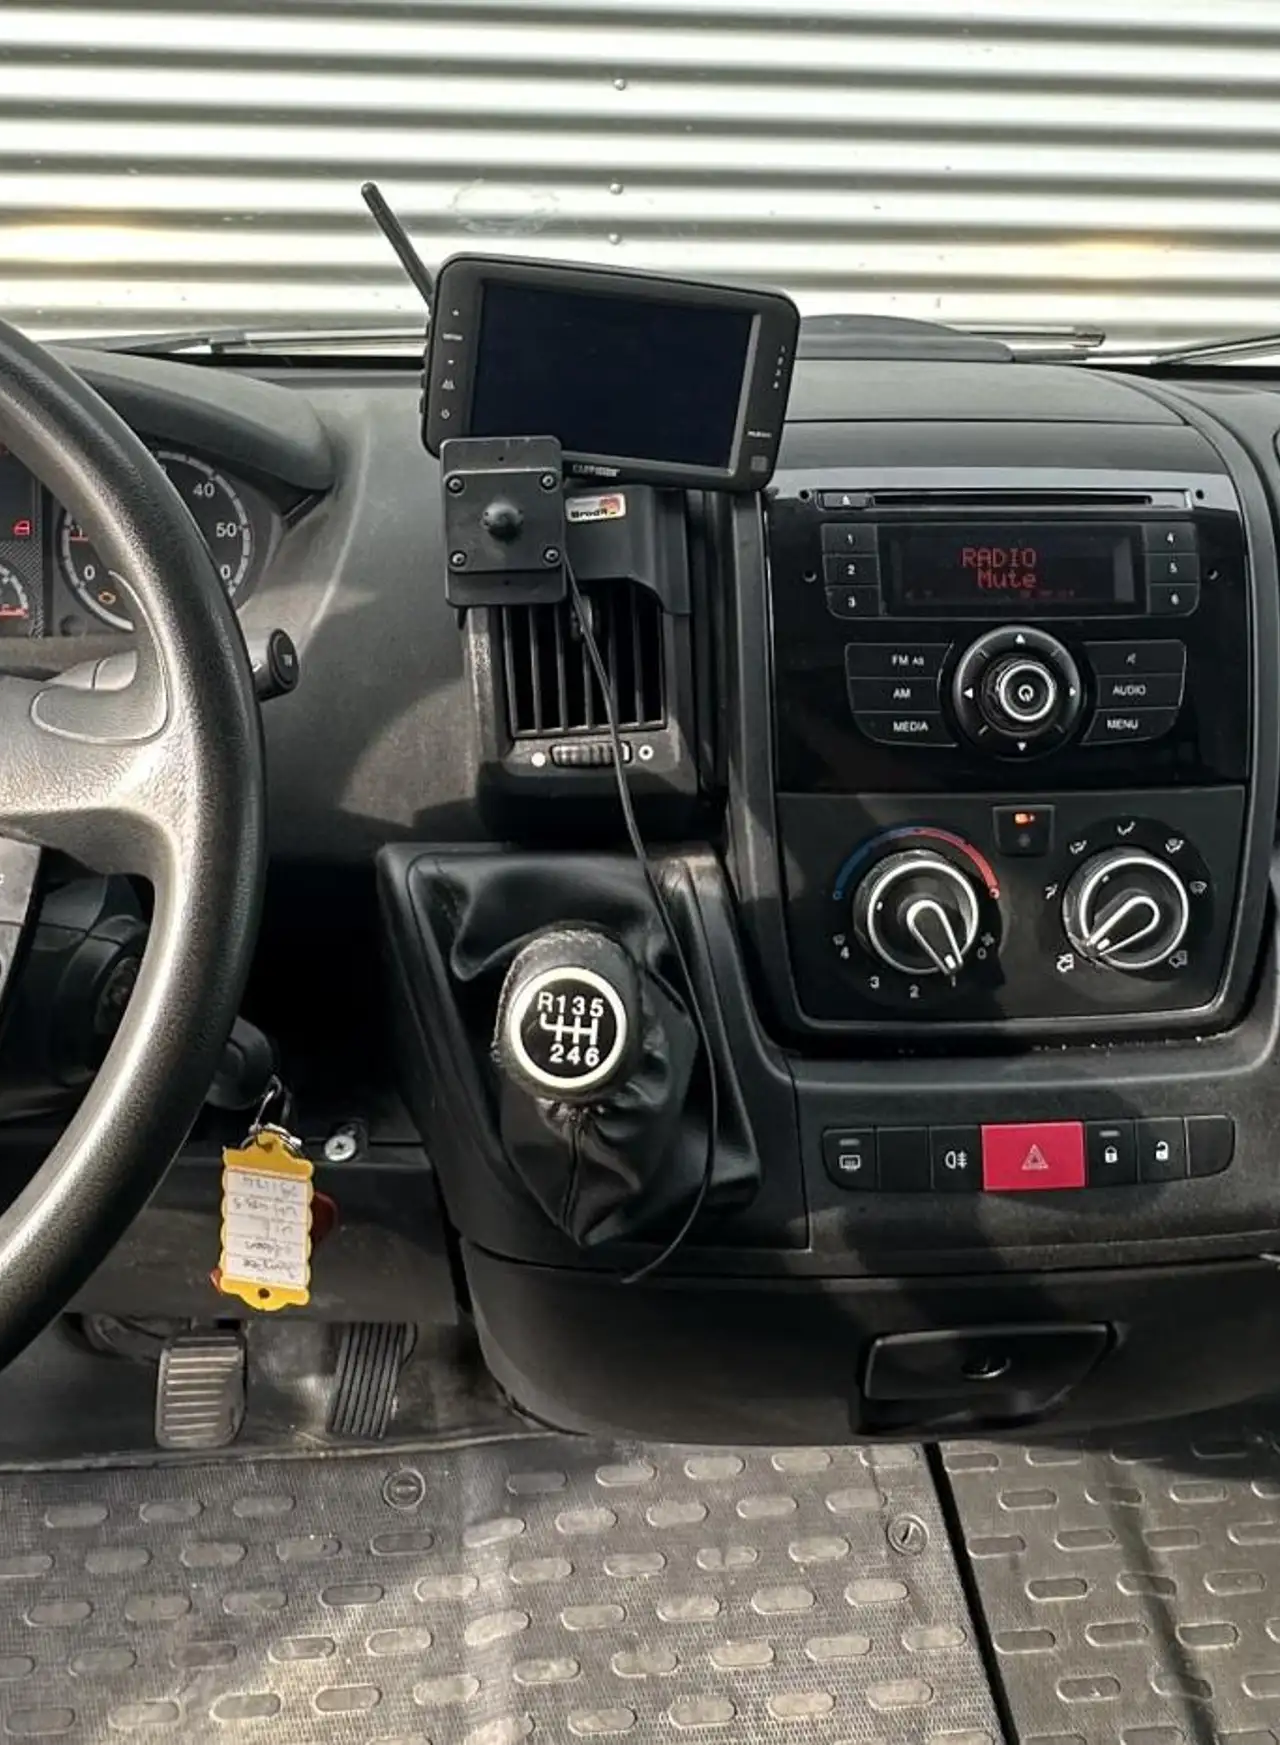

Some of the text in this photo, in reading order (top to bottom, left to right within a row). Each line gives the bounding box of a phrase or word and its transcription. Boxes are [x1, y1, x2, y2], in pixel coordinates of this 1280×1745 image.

[193, 482, 216, 498] 40
[216, 522, 239, 538] 50
[1166, 532, 1175, 544] 4
[962, 547, 1037, 568] RADIO
[84, 565, 95, 580] 0
[847, 564, 856, 576] 2
[1170, 562, 1178, 574] 5
[977, 569, 1037, 588] Mute
[847, 596, 857, 608] 3
[1170, 593, 1180, 605] 6
[891, 654, 910, 666] FM
[893, 687, 911, 699] AM
[1112, 684, 1146, 696] AUDIO
[893, 721, 928, 732] MEDIA
[1107, 718, 1138, 730] MENU
[840, 946, 850, 959] 4
[977, 947, 987, 960] 0
[870, 976, 880, 989] 3
[910, 985, 919, 998] 2
